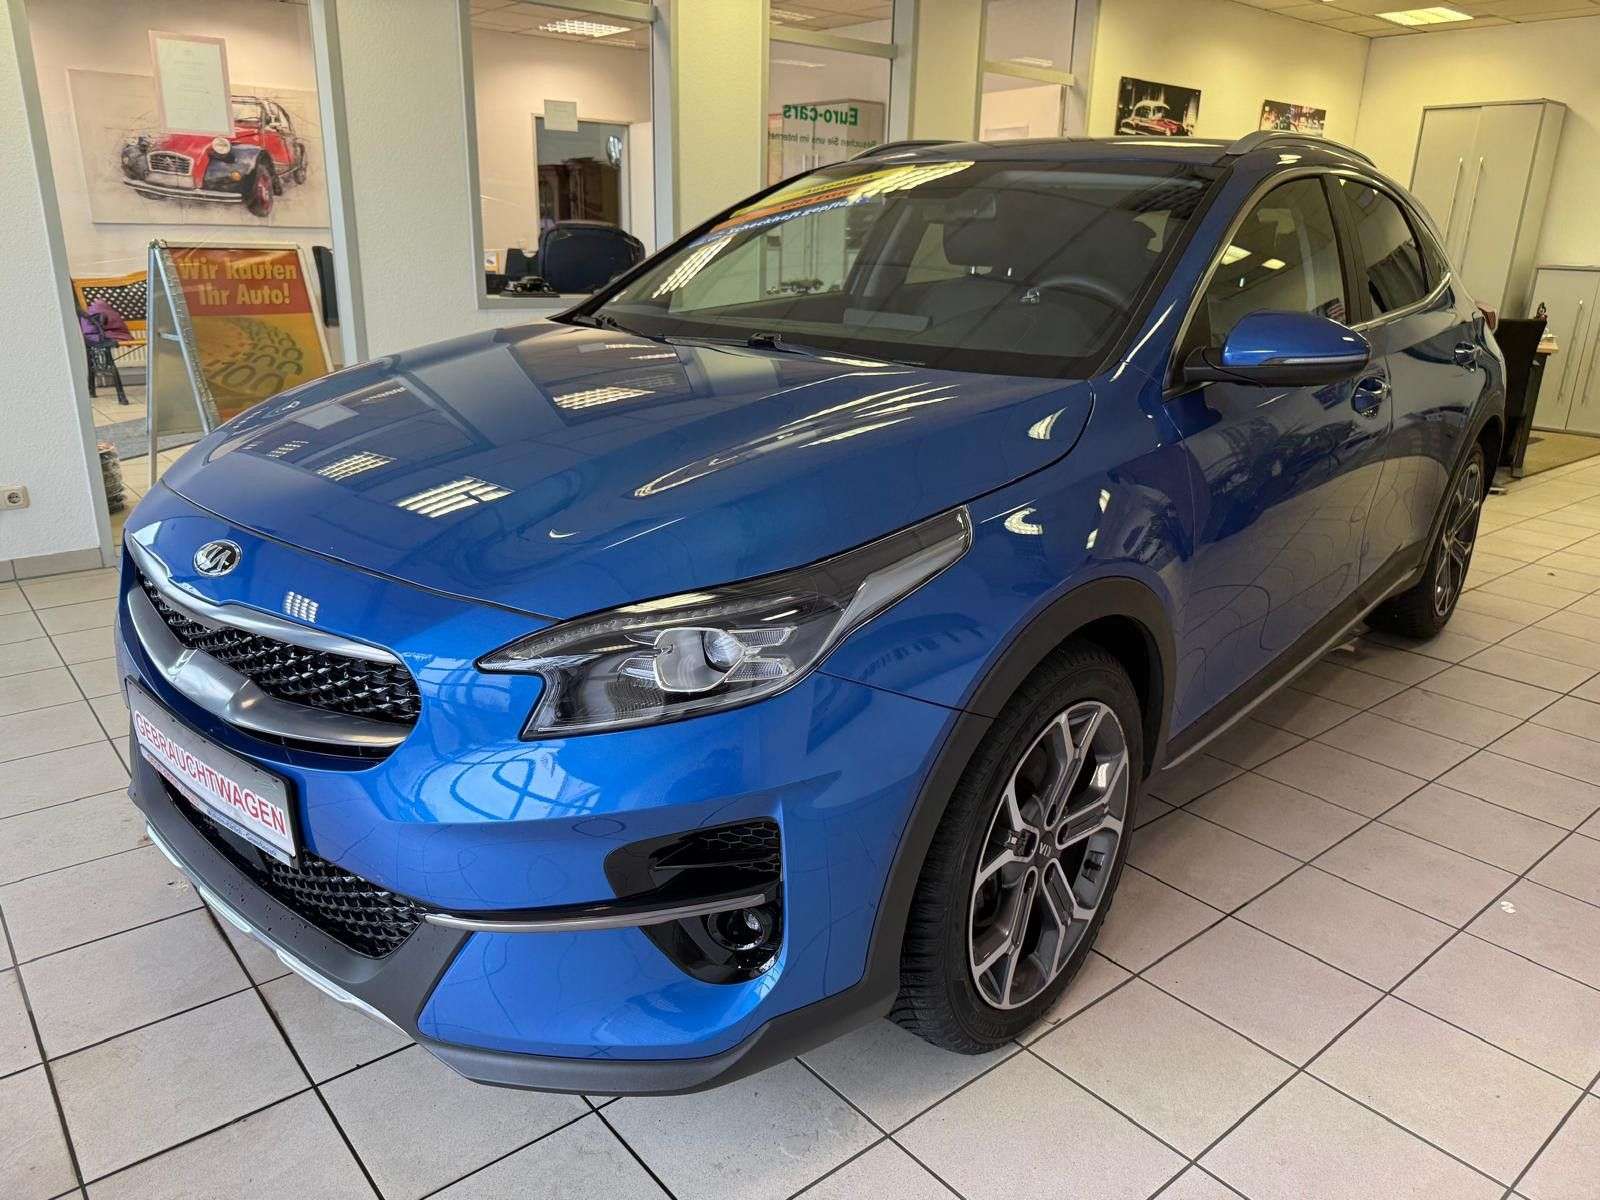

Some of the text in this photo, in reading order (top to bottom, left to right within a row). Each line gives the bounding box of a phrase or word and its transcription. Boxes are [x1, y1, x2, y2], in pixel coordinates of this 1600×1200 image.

[177, 256, 297, 280] Wir kaufen
[199, 282, 290, 305] Ihr Auto!
[134, 712, 287, 835] GEBRAUCHTWAGEN
